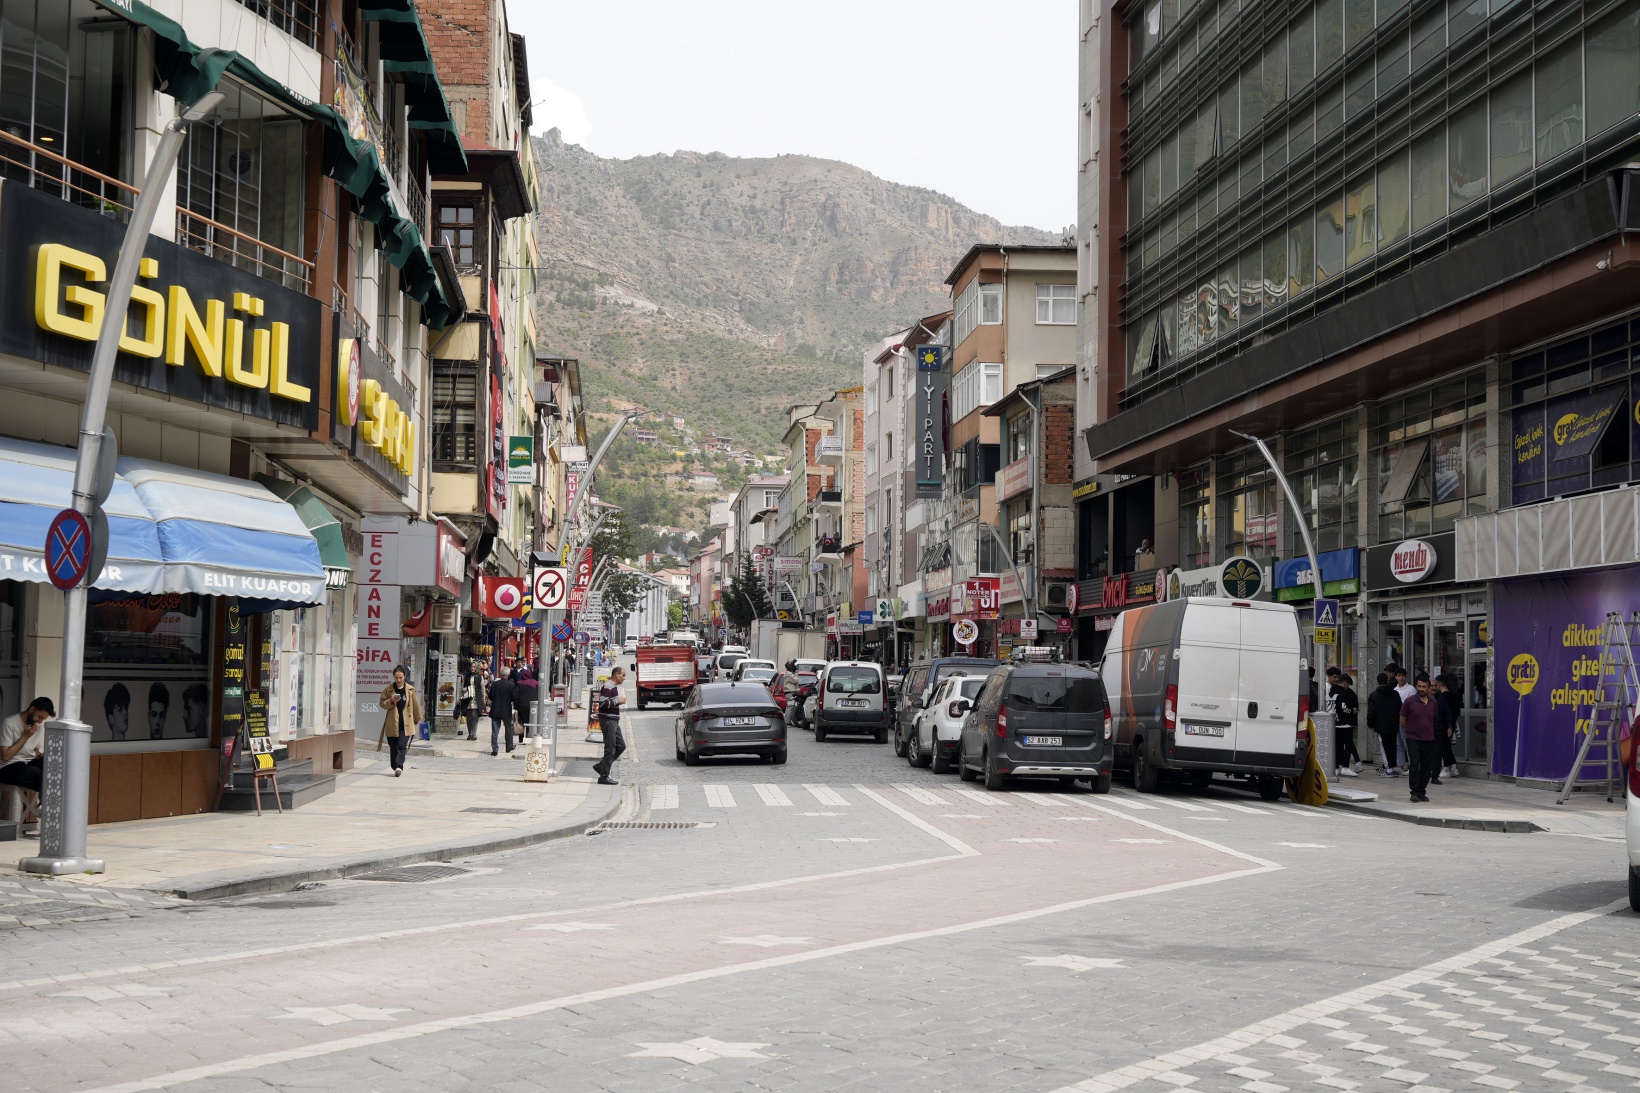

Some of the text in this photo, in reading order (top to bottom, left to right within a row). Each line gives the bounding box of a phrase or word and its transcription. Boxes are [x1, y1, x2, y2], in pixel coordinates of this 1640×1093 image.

[35, 243, 311, 403] GÖNÜL
[241, 576, 313, 596] KUAFÖR
[366, 534, 384, 637] ECZANE
[1562, 622, 1605, 647] dikkat!
[356, 646, 392, 665] ŞİFA
[1511, 658, 1536, 684] gratis
[360, 702, 379, 711] SGK
[1027, 736, 1061, 745] 52 AAB 253
